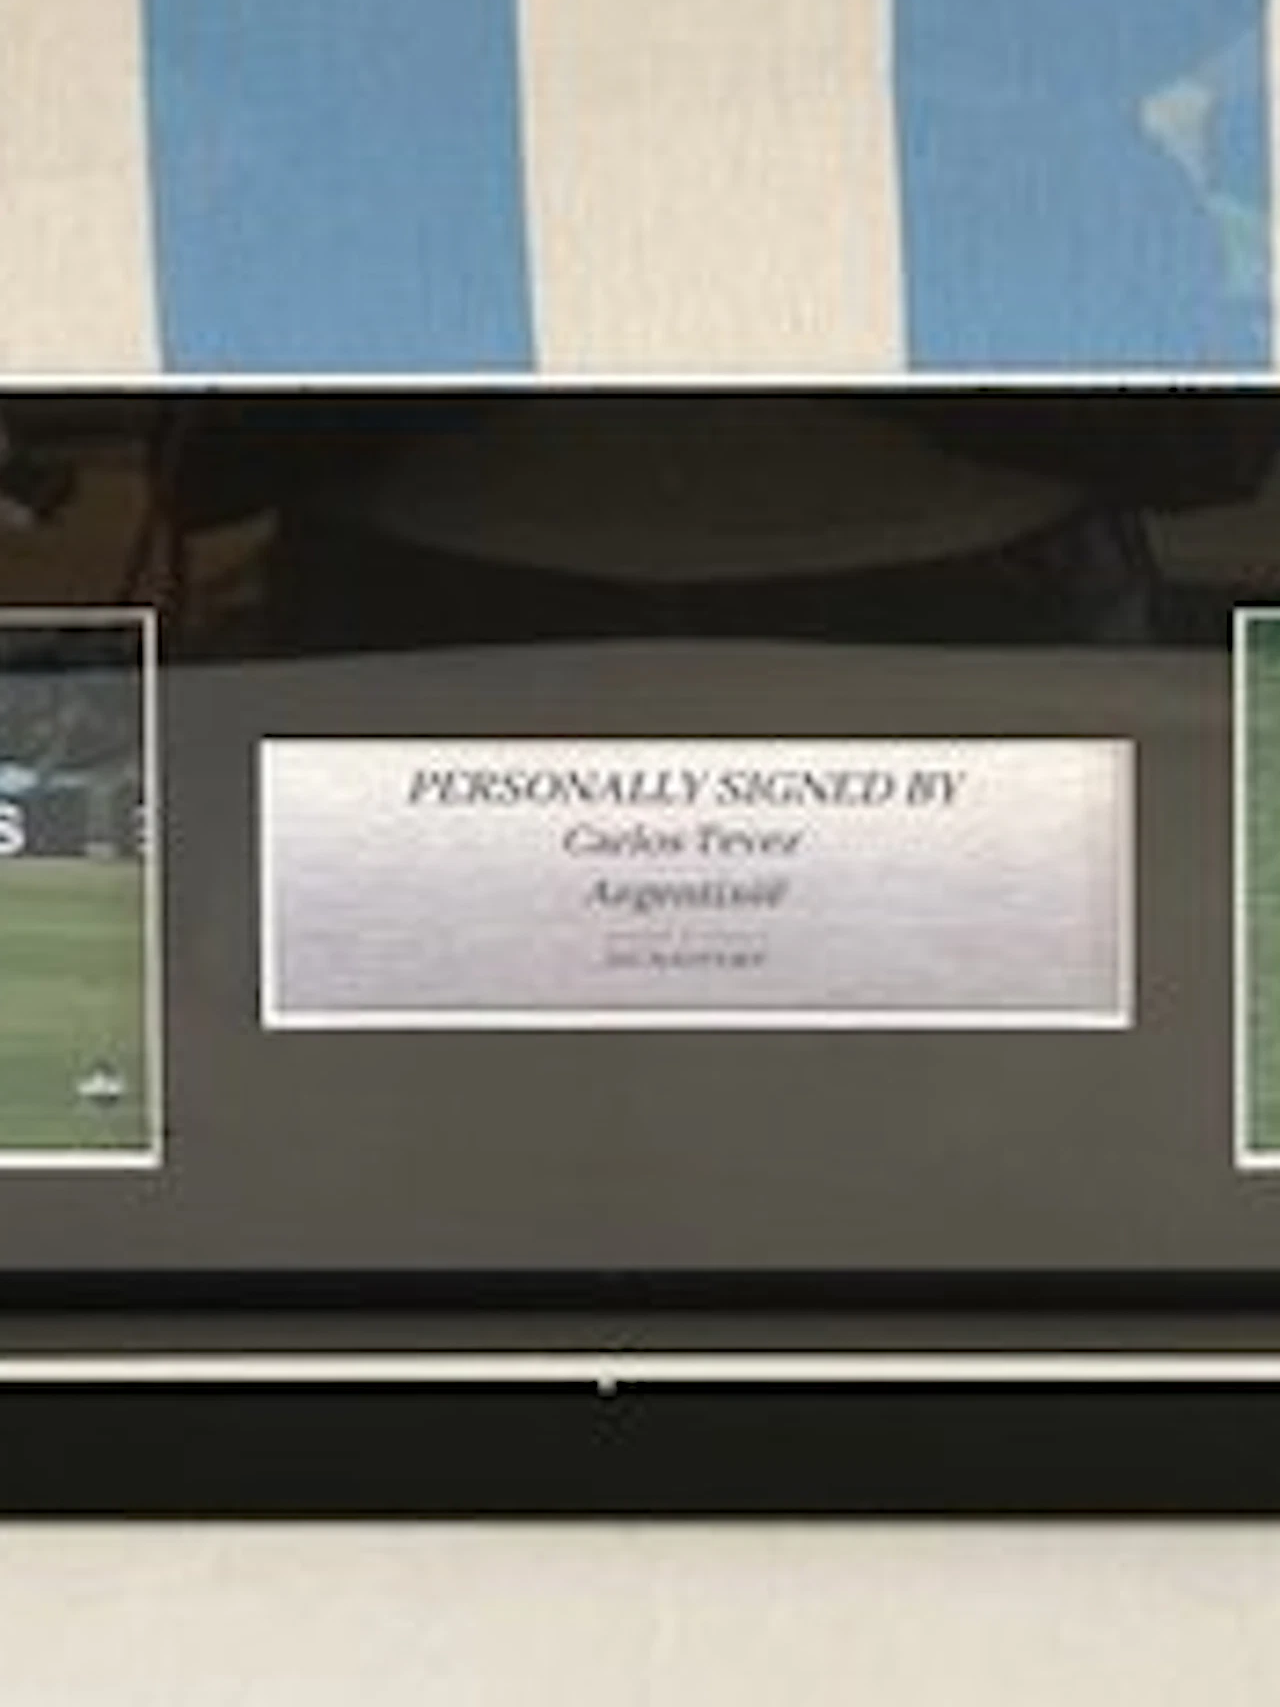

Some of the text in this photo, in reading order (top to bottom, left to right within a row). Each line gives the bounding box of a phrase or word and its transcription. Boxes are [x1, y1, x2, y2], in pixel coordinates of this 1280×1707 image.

[407, 769, 968, 807] PERSONALLY SIGNED BY
[563, 823, 806, 857] Carlos Tevez
